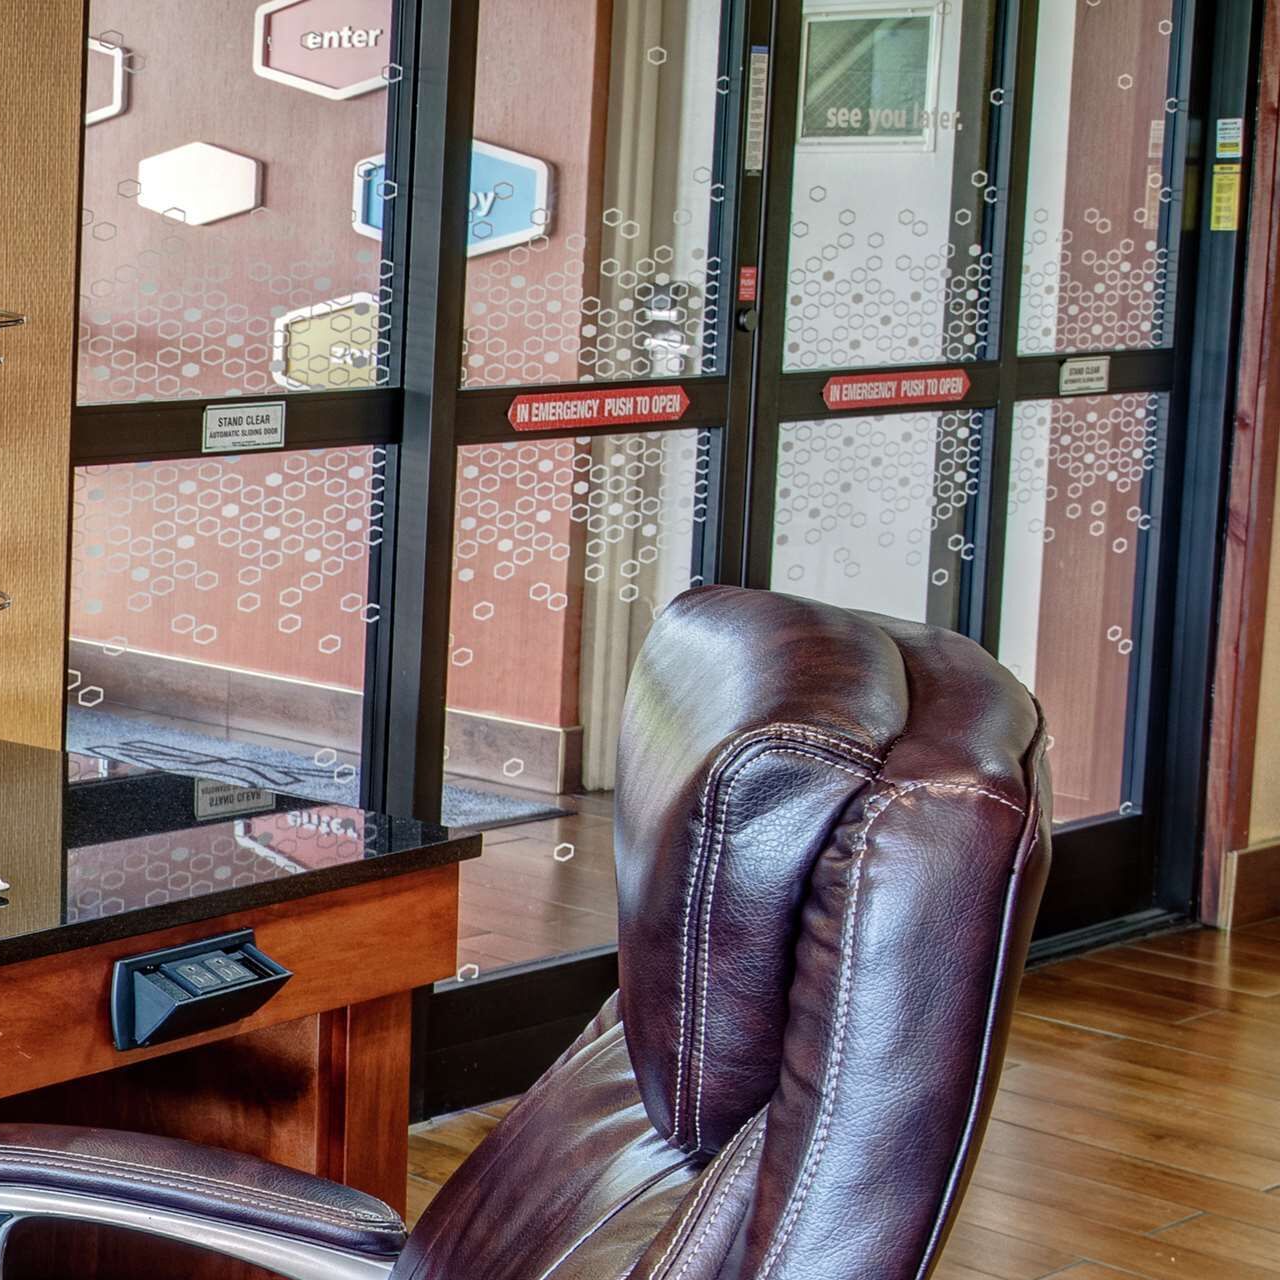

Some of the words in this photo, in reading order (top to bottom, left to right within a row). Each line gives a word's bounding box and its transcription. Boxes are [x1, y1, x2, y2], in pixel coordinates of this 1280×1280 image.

[307, 25, 382, 49] enter
[826, 107, 862, 129] see
[868, 107, 906, 135] you
[913, 101, 963, 131] later.
[830, 384, 841, 402] IN
[842, 381, 897, 401] EMERGENCY
[901, 379, 925, 397] PUSH
[927, 378, 938, 396] TO
[939, 376, 963, 394] OPEN
[217, 415, 243, 428] STAND
[245, 413, 271, 426] CLEAR
[516, 404, 529, 423] IN
[531, 399, 600, 422] EMERGENCY
[604, 397, 634, 417] PUSH
[636, 396, 649, 414] TO
[651, 394, 681, 413] OPEN
